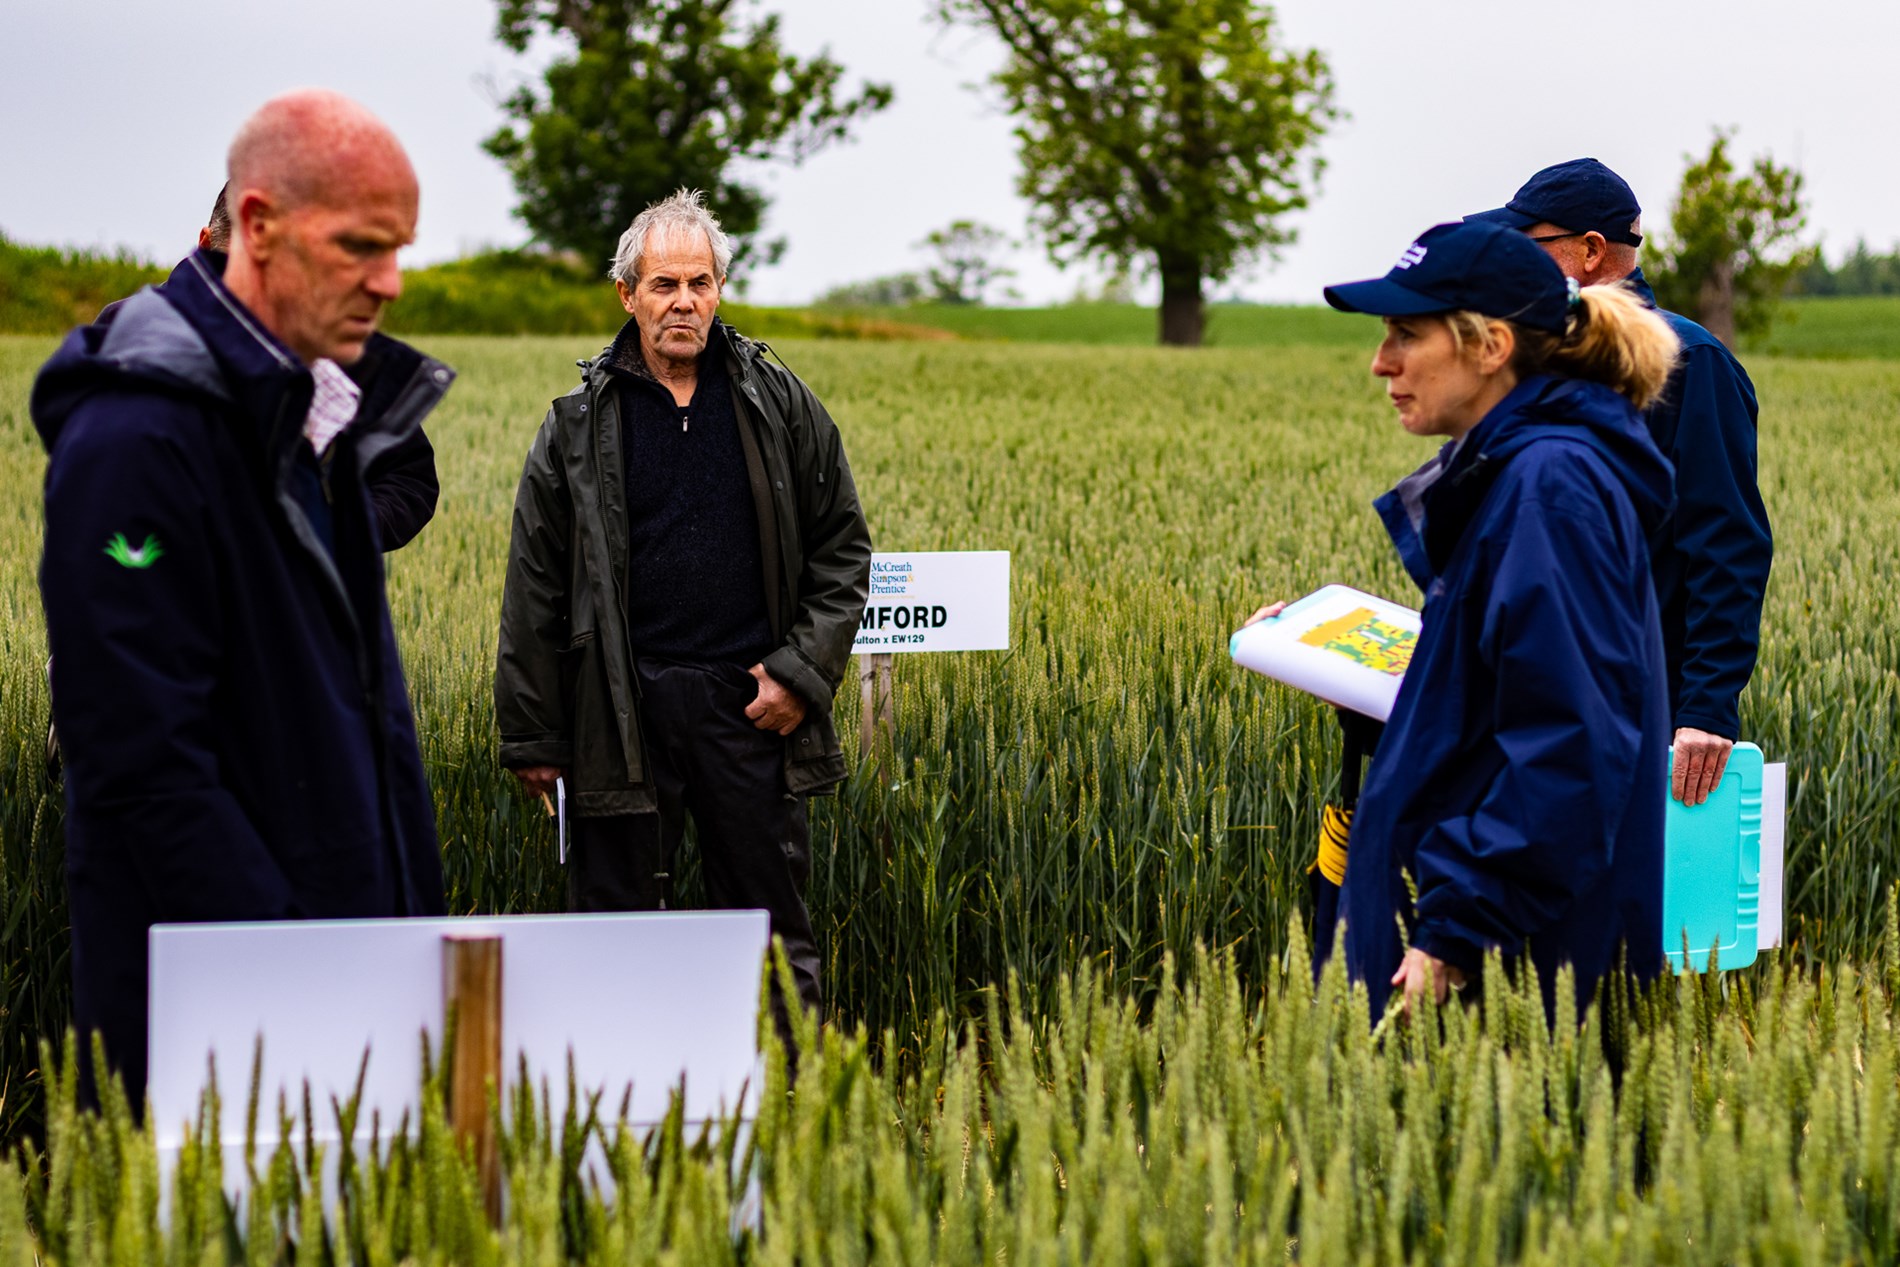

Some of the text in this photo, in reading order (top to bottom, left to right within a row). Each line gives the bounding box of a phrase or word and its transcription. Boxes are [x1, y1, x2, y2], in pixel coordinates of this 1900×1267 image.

[871, 562, 912, 572] McCreath
[871, 583, 906, 594] Prentice
[891, 634, 925, 644] EW129
